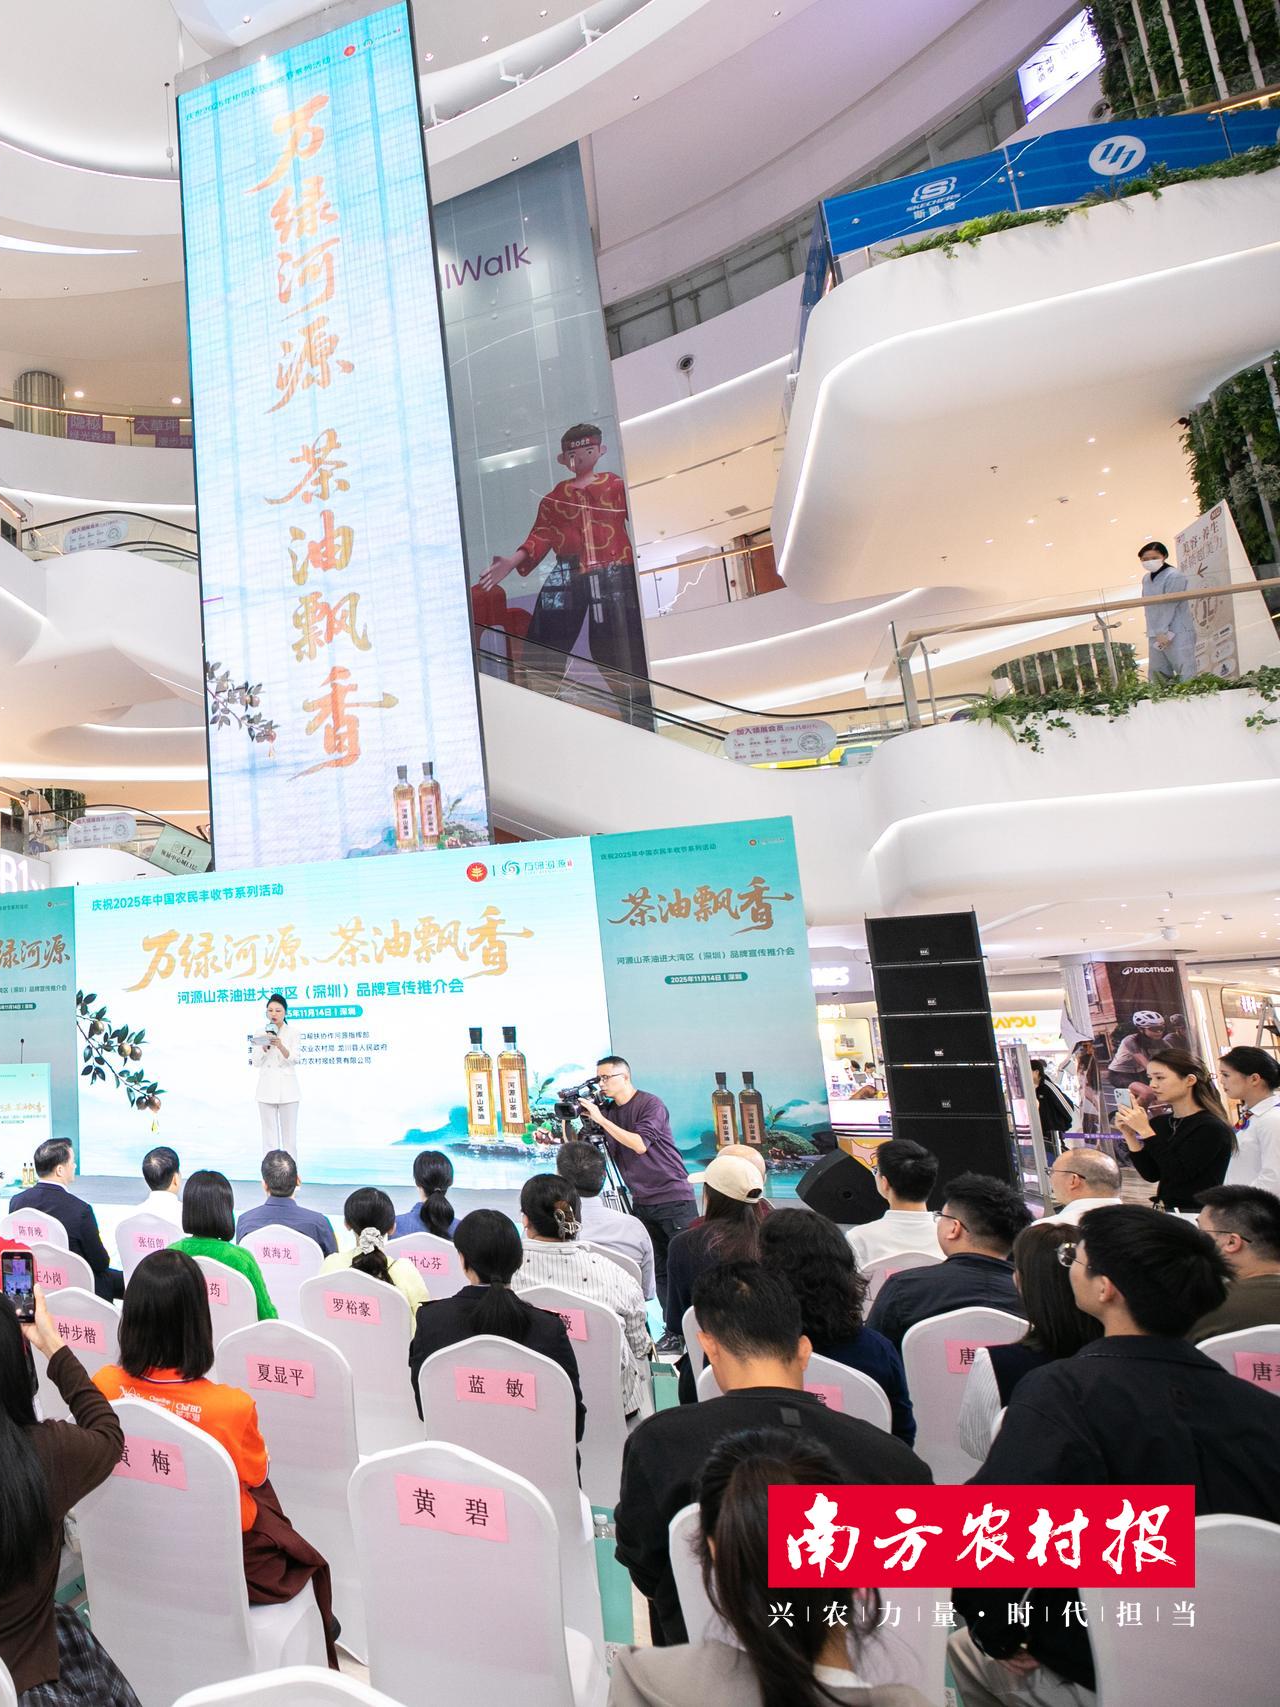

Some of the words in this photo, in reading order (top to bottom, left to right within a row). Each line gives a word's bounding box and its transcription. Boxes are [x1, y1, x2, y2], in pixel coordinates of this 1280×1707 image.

[905, 193, 962, 211] SKECHERS
[244, 94, 355, 415] 万绿河源
[264, 427, 398, 780] 茶油飘香
[91, 883, 284, 911] 庆祝2025年中国农民丰收节系列活动
[607, 877, 794, 936] 茶油飘香
[122, 928, 310, 993] 万绿河源
[311, 905, 535, 982] 茶油飘香
[1133, 966, 1174, 974] DECATHLON
[332, 1298, 371, 1318] 罗裕豪
[58, 1321, 96, 1345] 钟步楷
[257, 1363, 304, 1387] 夏显平
[1253, 1360, 1280, 1381] 唐
